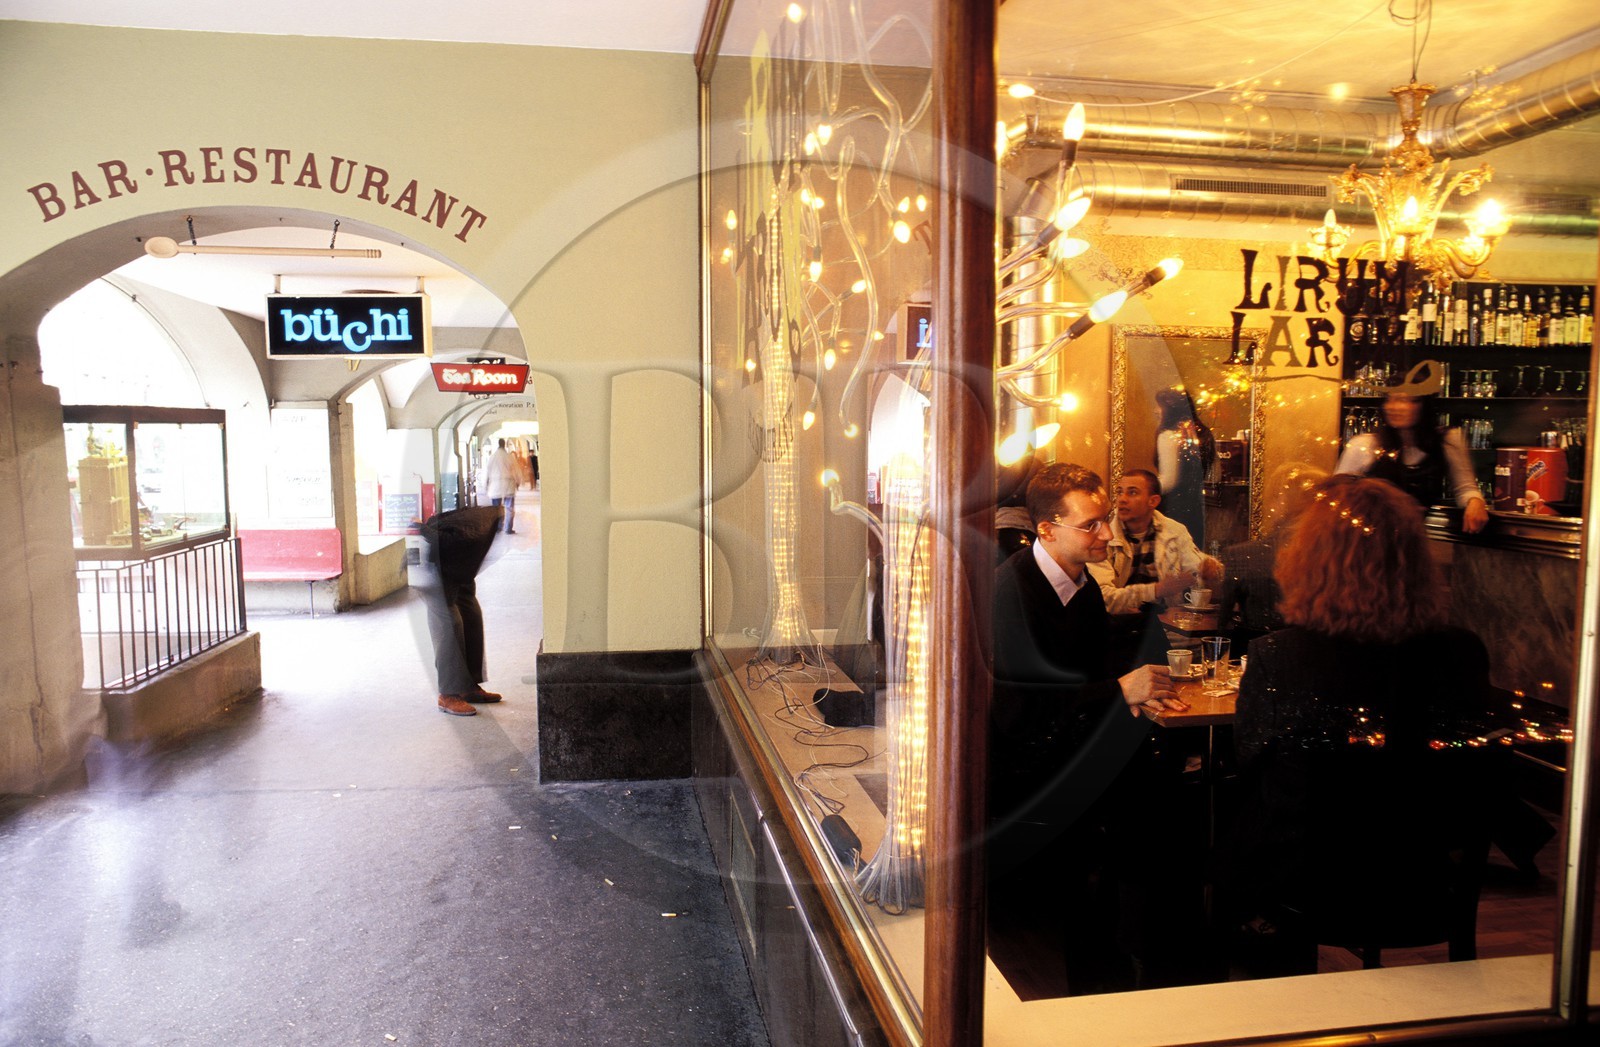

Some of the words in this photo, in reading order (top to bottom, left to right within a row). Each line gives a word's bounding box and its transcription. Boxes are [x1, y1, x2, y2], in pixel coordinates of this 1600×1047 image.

[280, 307, 412, 352] büchi
[442, 368, 470, 384] Tea
[471, 368, 518, 385] Room
